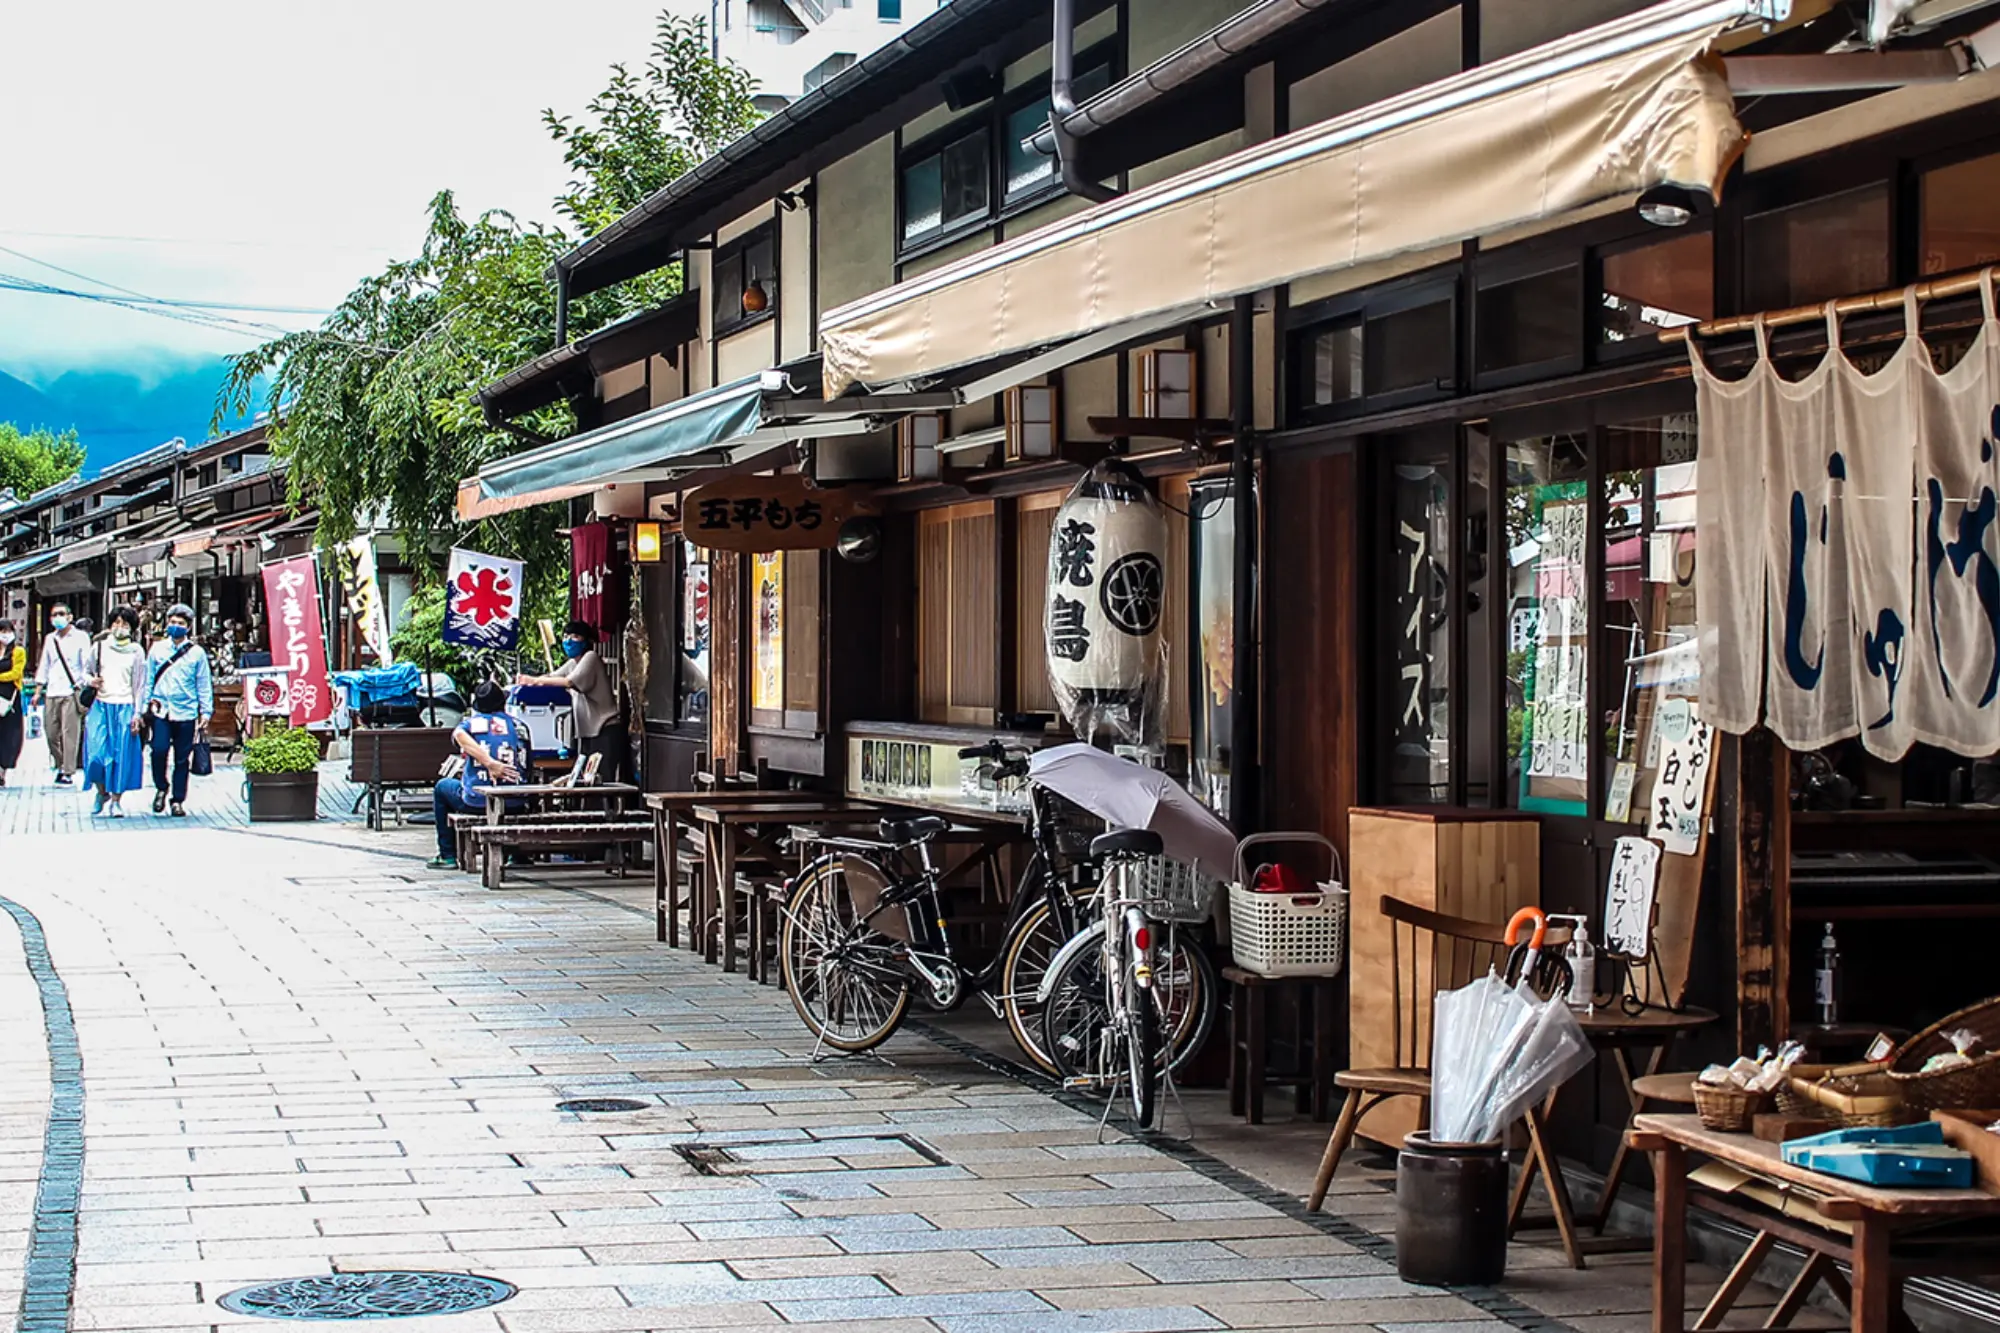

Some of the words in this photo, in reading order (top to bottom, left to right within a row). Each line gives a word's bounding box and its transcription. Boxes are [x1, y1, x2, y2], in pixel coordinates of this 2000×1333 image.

[698, 498, 823, 530] 五平もち
[275, 569, 311, 678] やきとり
[1051, 518, 1097, 663] 焼鳥
[1399, 519, 1425, 727] アイス
[1561, 708, 1572, 760] ライス
[1655, 747, 1681, 831] 白玉
